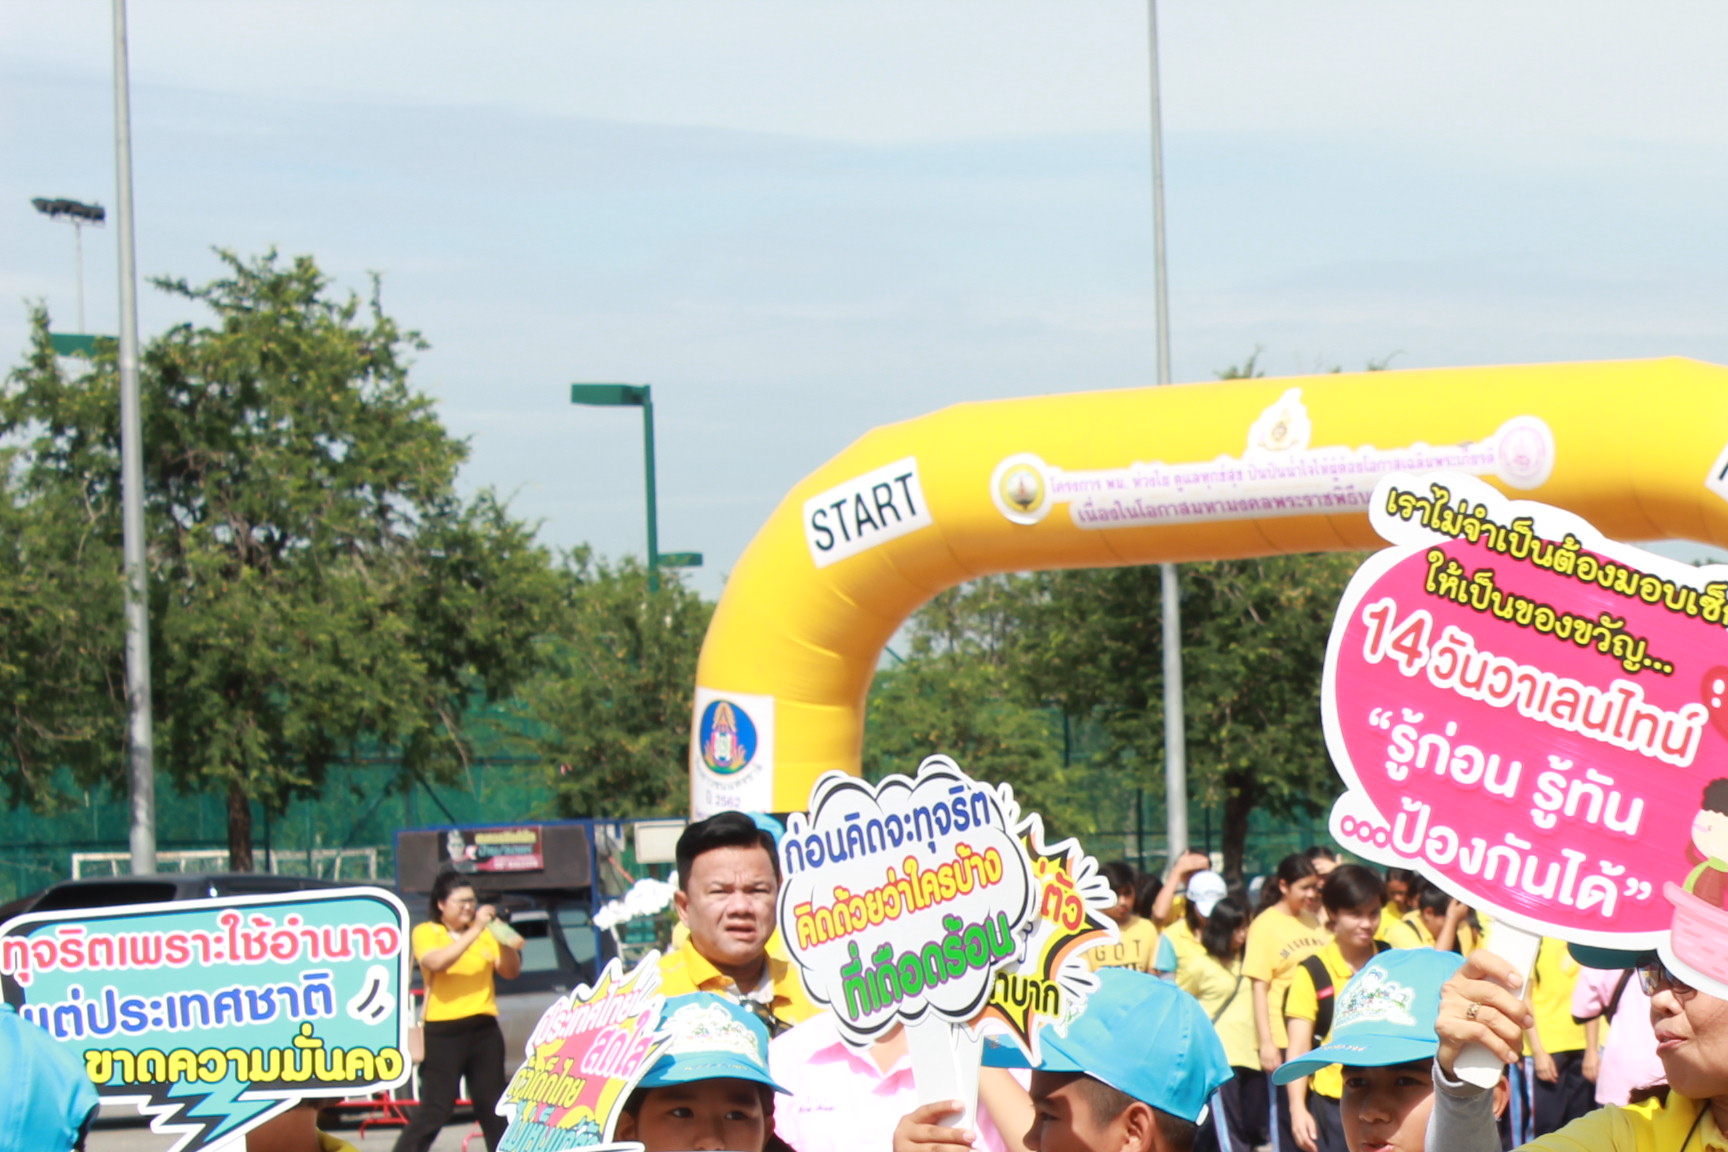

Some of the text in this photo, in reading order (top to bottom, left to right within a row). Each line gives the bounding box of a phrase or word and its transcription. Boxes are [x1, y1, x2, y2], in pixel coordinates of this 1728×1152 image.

[811, 472, 919, 552] START
[785, 786, 991, 874] ก่อนคิดจะทุจริต
[1534, 756, 1643, 835] รู้ทัน
[794, 842, 1004, 950] คิดด้วยว่าใครบ้าง
[3, 916, 398, 983] ทุจริตเพราะใช้อำนาจ
[842, 911, 1016, 1022] ที่เดือดร้อน
[85, 1022, 404, 1084] ขาดความมั่นคง
